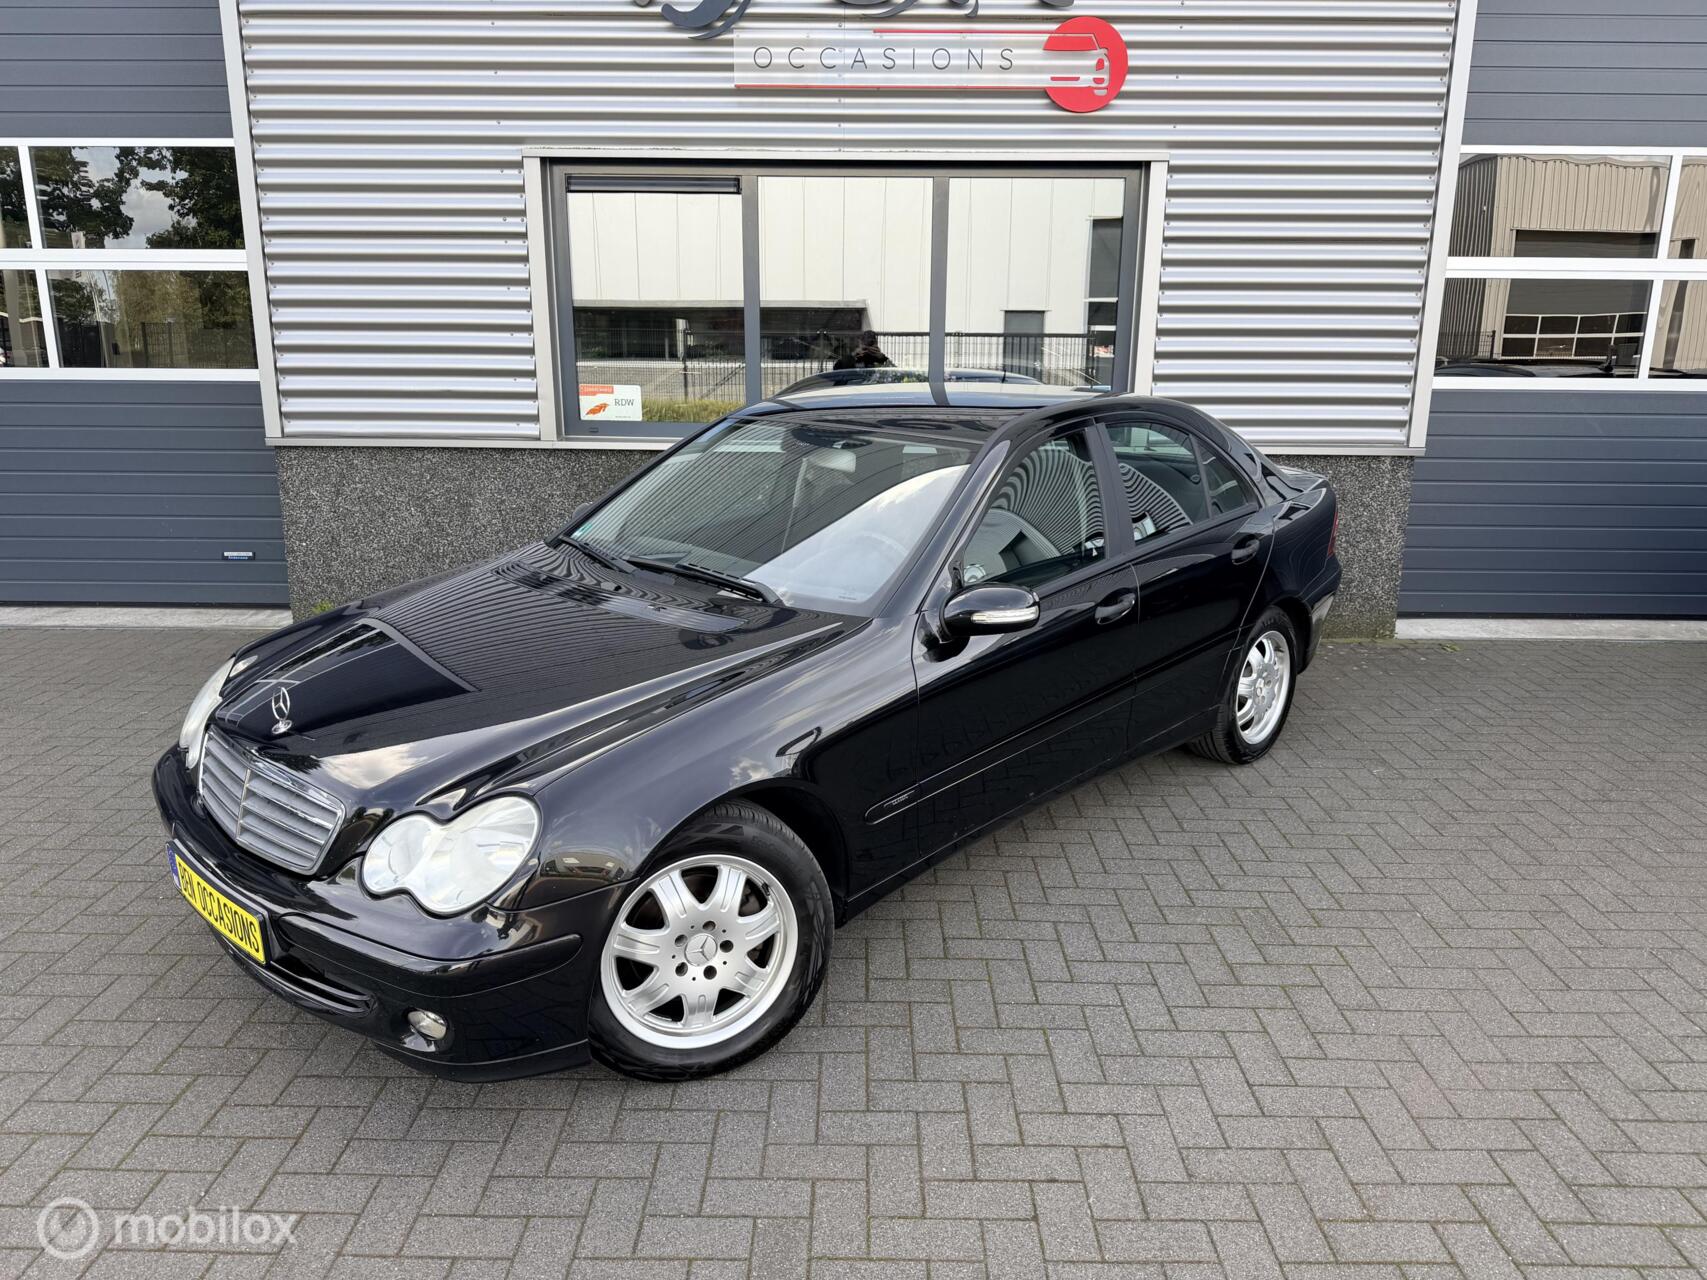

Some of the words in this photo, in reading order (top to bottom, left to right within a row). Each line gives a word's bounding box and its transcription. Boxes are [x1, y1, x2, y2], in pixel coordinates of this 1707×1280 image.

[753, 46, 1014, 71] OCCASIONS
[614, 398, 635, 407] RDW
[197, 880, 260, 954] OCCASIONS
